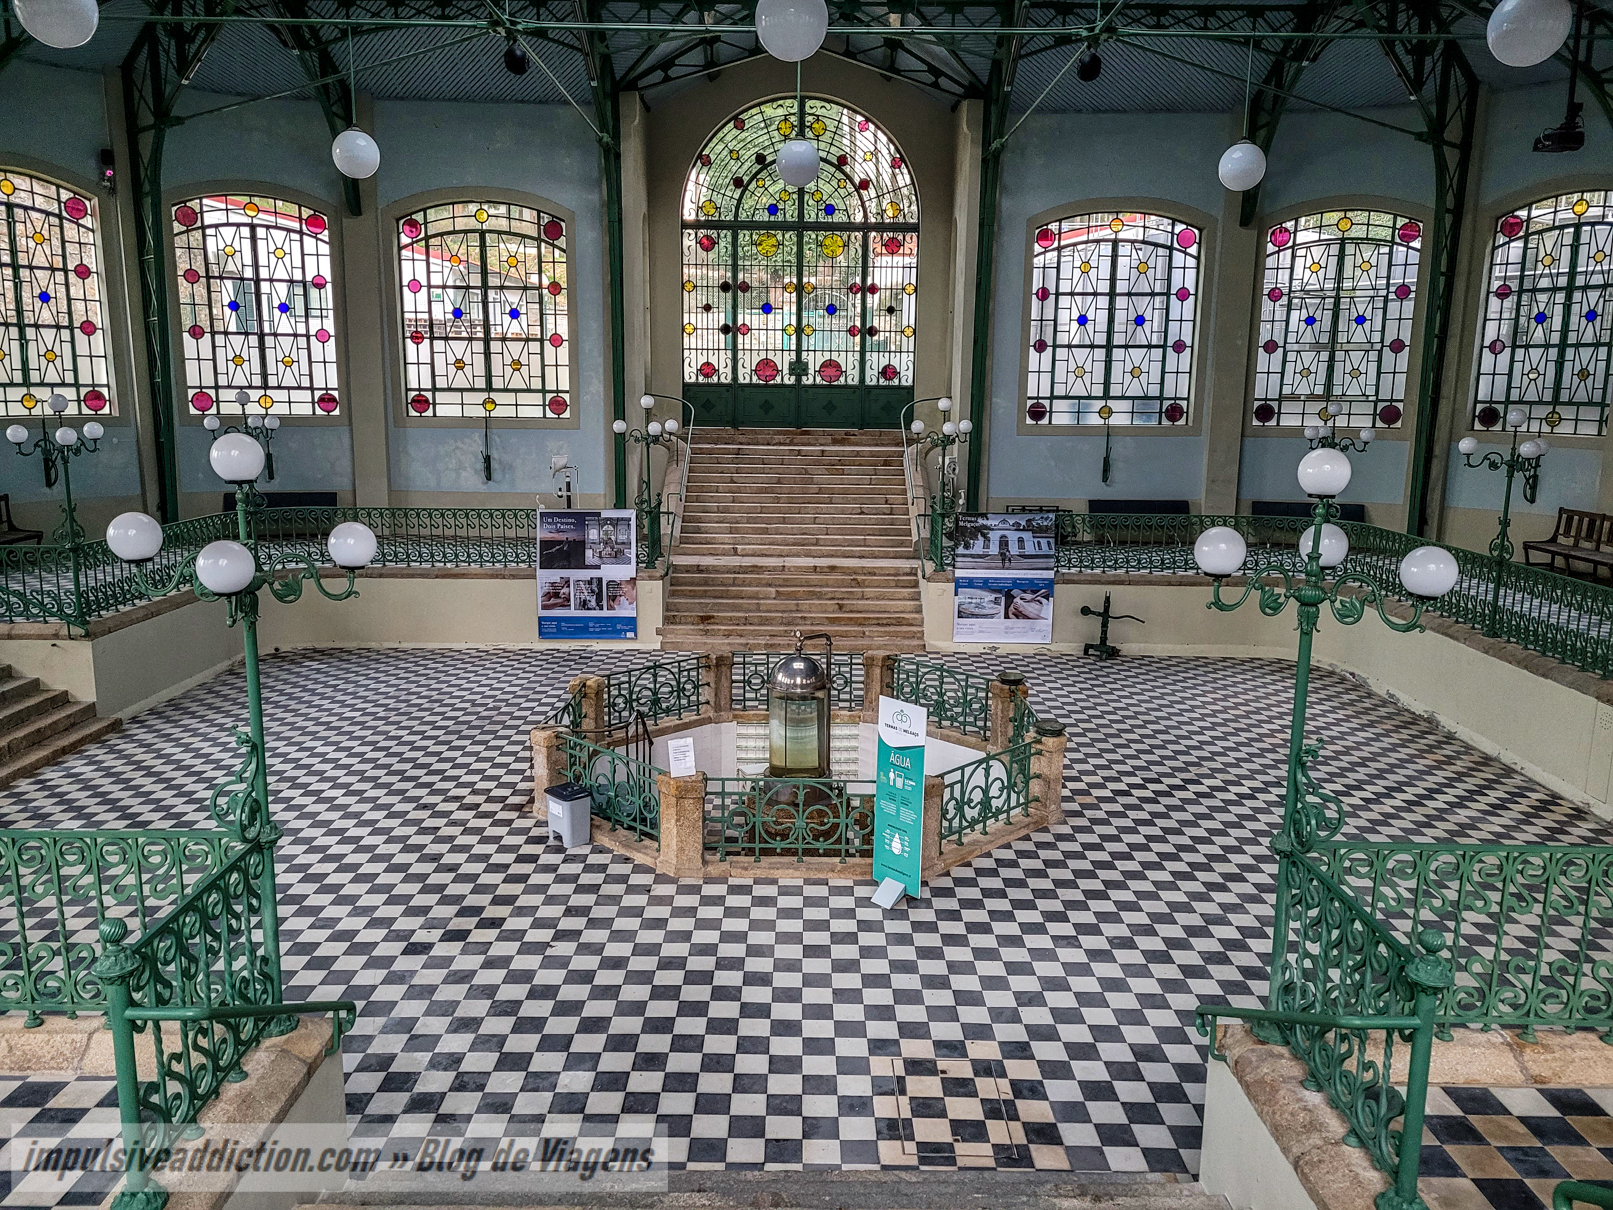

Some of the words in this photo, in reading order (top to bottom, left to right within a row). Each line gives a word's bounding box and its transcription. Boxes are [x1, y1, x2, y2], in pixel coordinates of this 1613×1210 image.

[884, 722, 898, 731] TERMAS
[902, 728, 920, 738] MELGAÇO
[889, 750, 911, 769] ÁGUA
